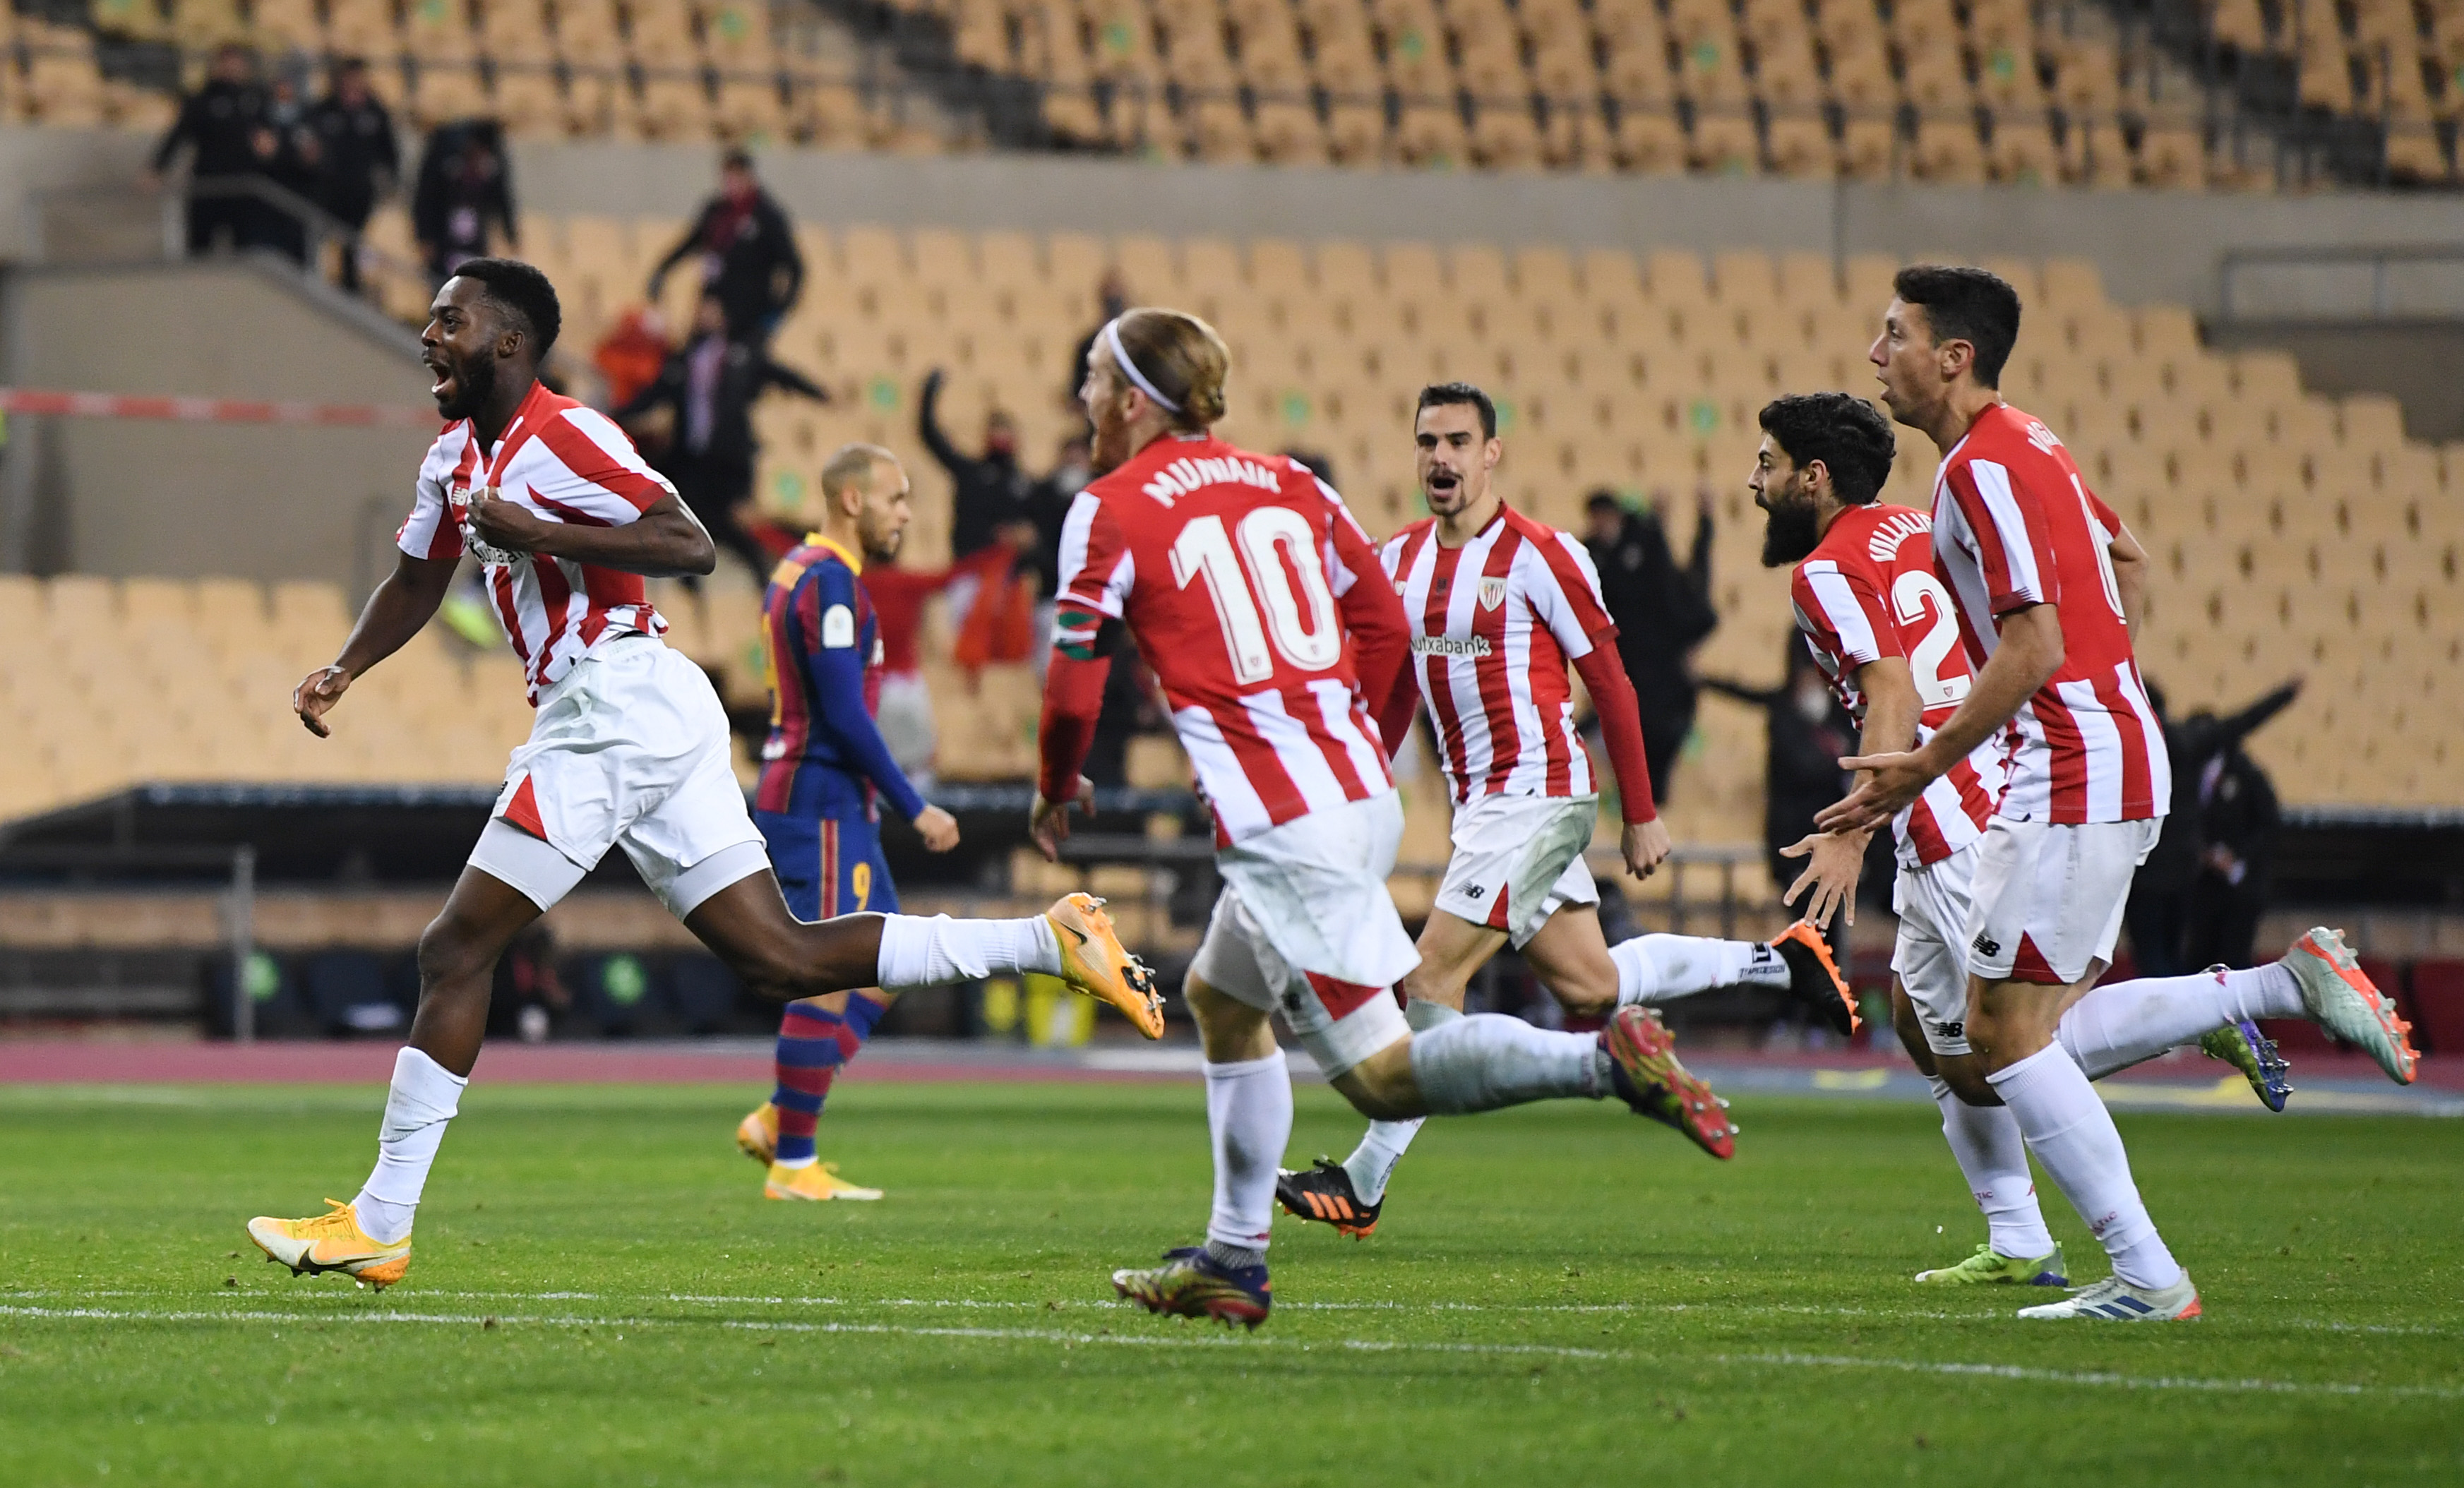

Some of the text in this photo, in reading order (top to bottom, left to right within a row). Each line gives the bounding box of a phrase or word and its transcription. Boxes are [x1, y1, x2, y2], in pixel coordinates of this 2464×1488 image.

[1141, 457, 1281, 509] MUNIAIN
[1168, 505, 1342, 685] 10
[852, 861, 871, 911] 9
